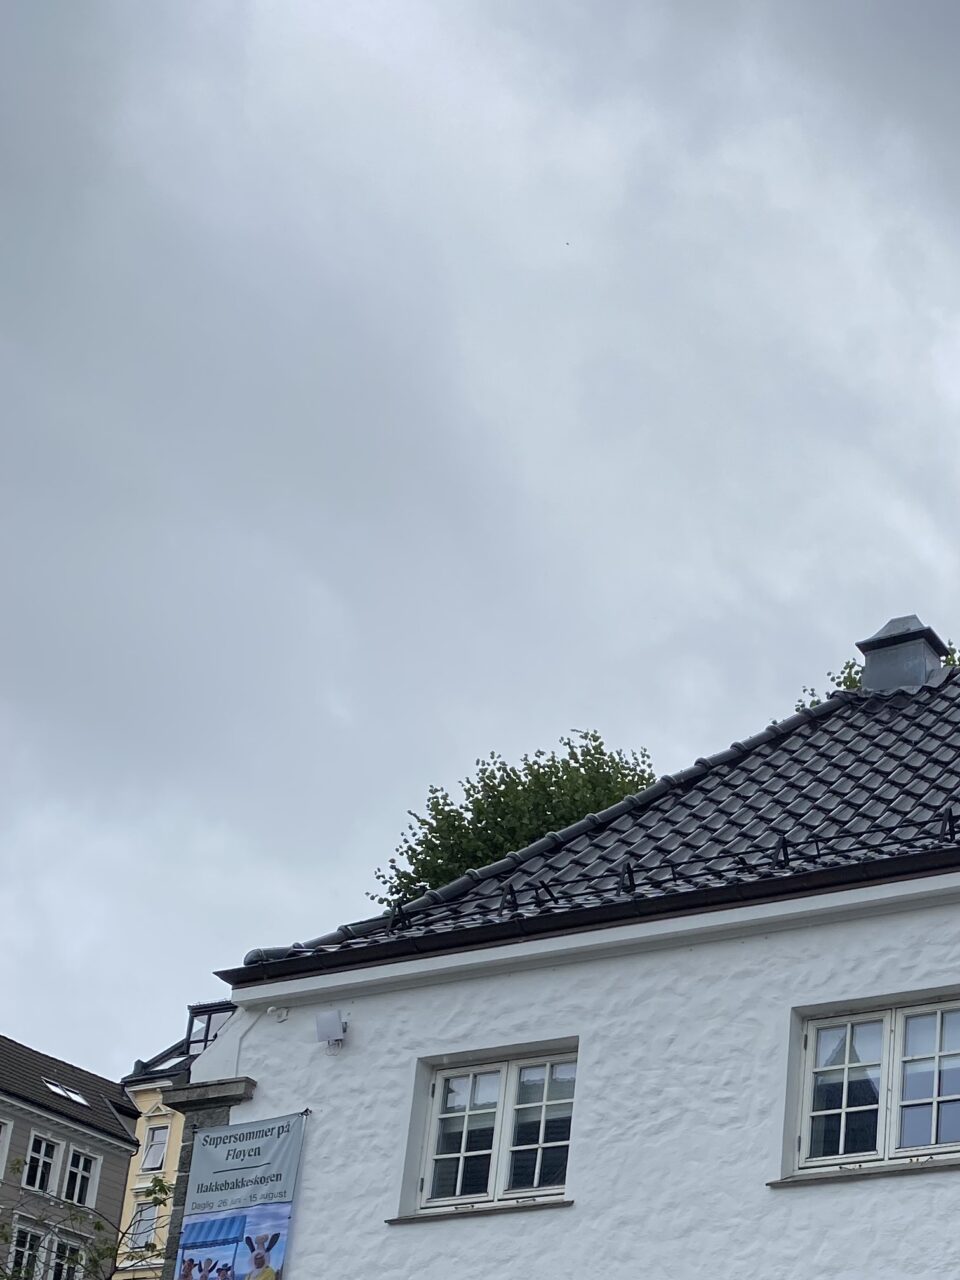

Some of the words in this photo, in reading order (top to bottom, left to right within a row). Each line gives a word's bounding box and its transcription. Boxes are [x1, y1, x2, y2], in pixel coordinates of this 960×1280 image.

[201, 1127, 276, 1149] Supersommer
[277, 1121, 291, 1139] på
[225, 1146, 261, 1162] Fløyen
[191, 1200, 214, 1211] Daglig
